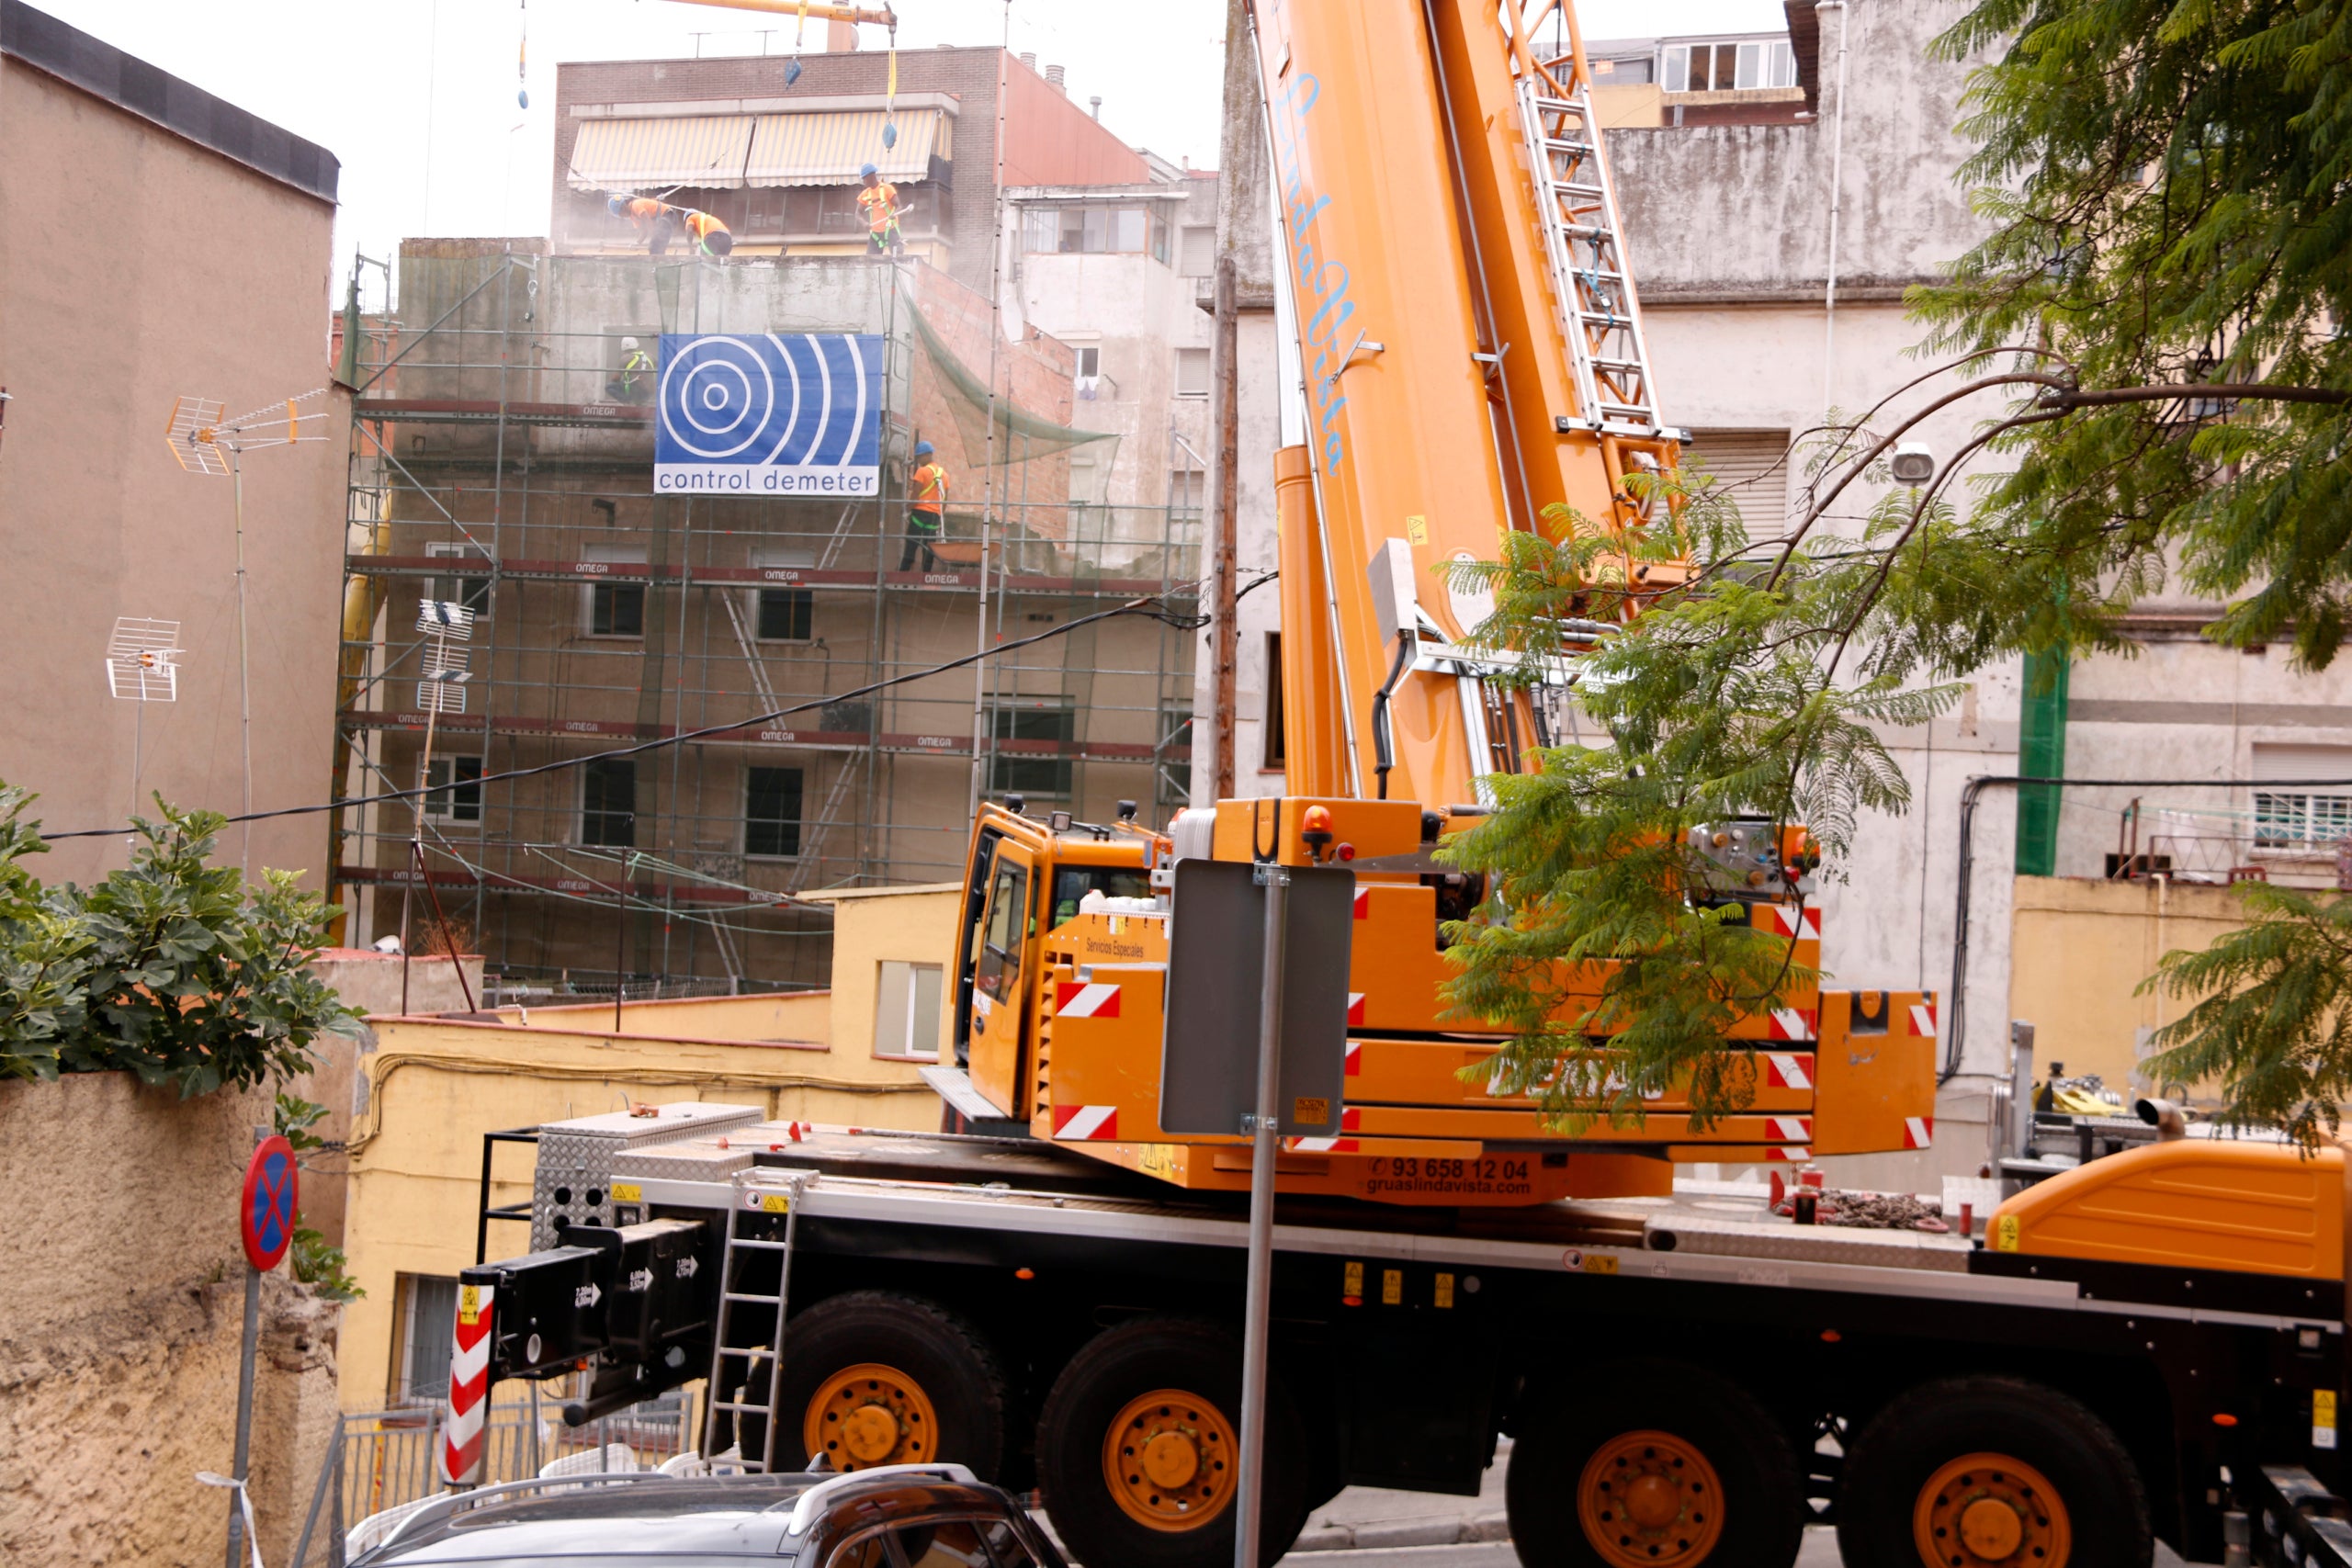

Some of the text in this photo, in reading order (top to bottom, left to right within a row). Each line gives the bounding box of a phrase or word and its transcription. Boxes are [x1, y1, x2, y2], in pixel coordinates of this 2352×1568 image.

[583, 407, 616, 417] OMEGA
[660, 469, 874, 491] control demeter
[575, 563, 608, 574] OMEGA
[765, 570, 798, 581] OMEGA
[924, 573, 959, 584] OMEGA
[565, 721, 598, 732] OMEGA
[761, 731, 794, 741] OMEGA
[917, 737, 952, 747] OMEGA
[393, 871, 425, 882] OMGA
[557, 880, 590, 891] OMEGA
[1086, 937, 1144, 959] Servicios Especiales
[1392, 1157, 1528, 1179] 93 658 12 04
[1366, 1177, 1531, 1195] gruaslindavista.com
